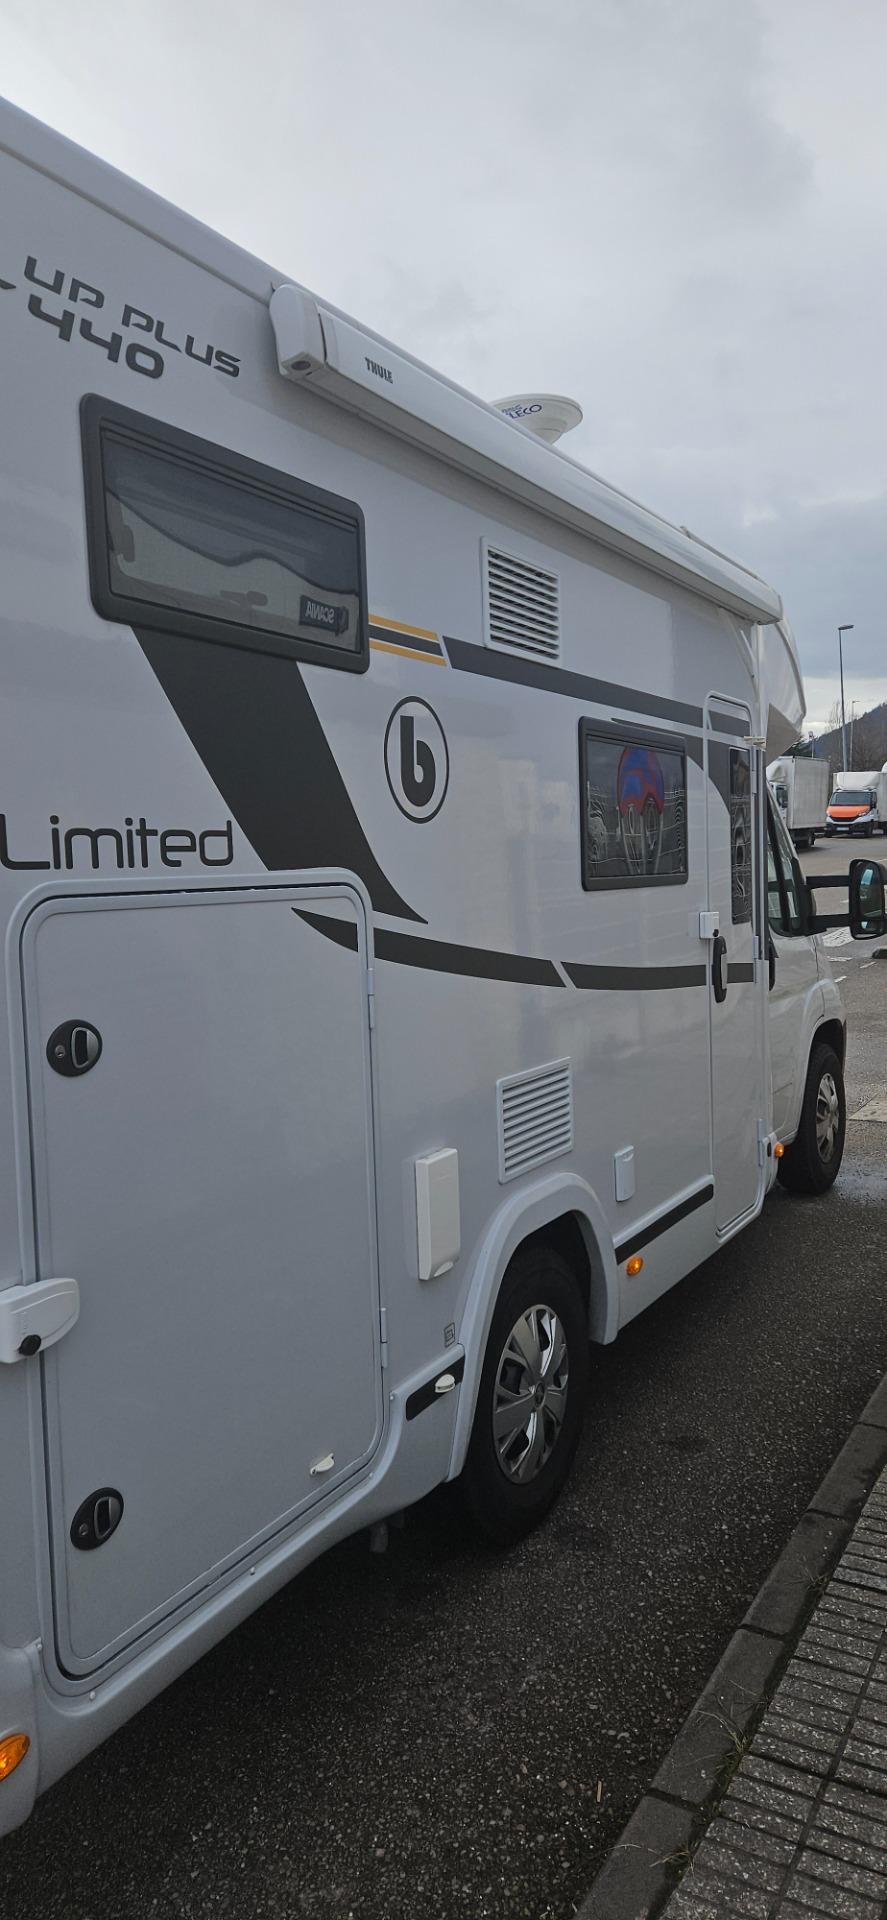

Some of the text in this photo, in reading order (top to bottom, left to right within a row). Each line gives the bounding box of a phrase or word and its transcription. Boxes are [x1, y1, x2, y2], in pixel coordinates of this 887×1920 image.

[27, 294, 164, 380] 440
[121, 304, 241, 378] PLUS
[364, 356, 394, 385] THULE
[506, 404, 543, 419] LECO
[0, 813, 234, 871] Limited
